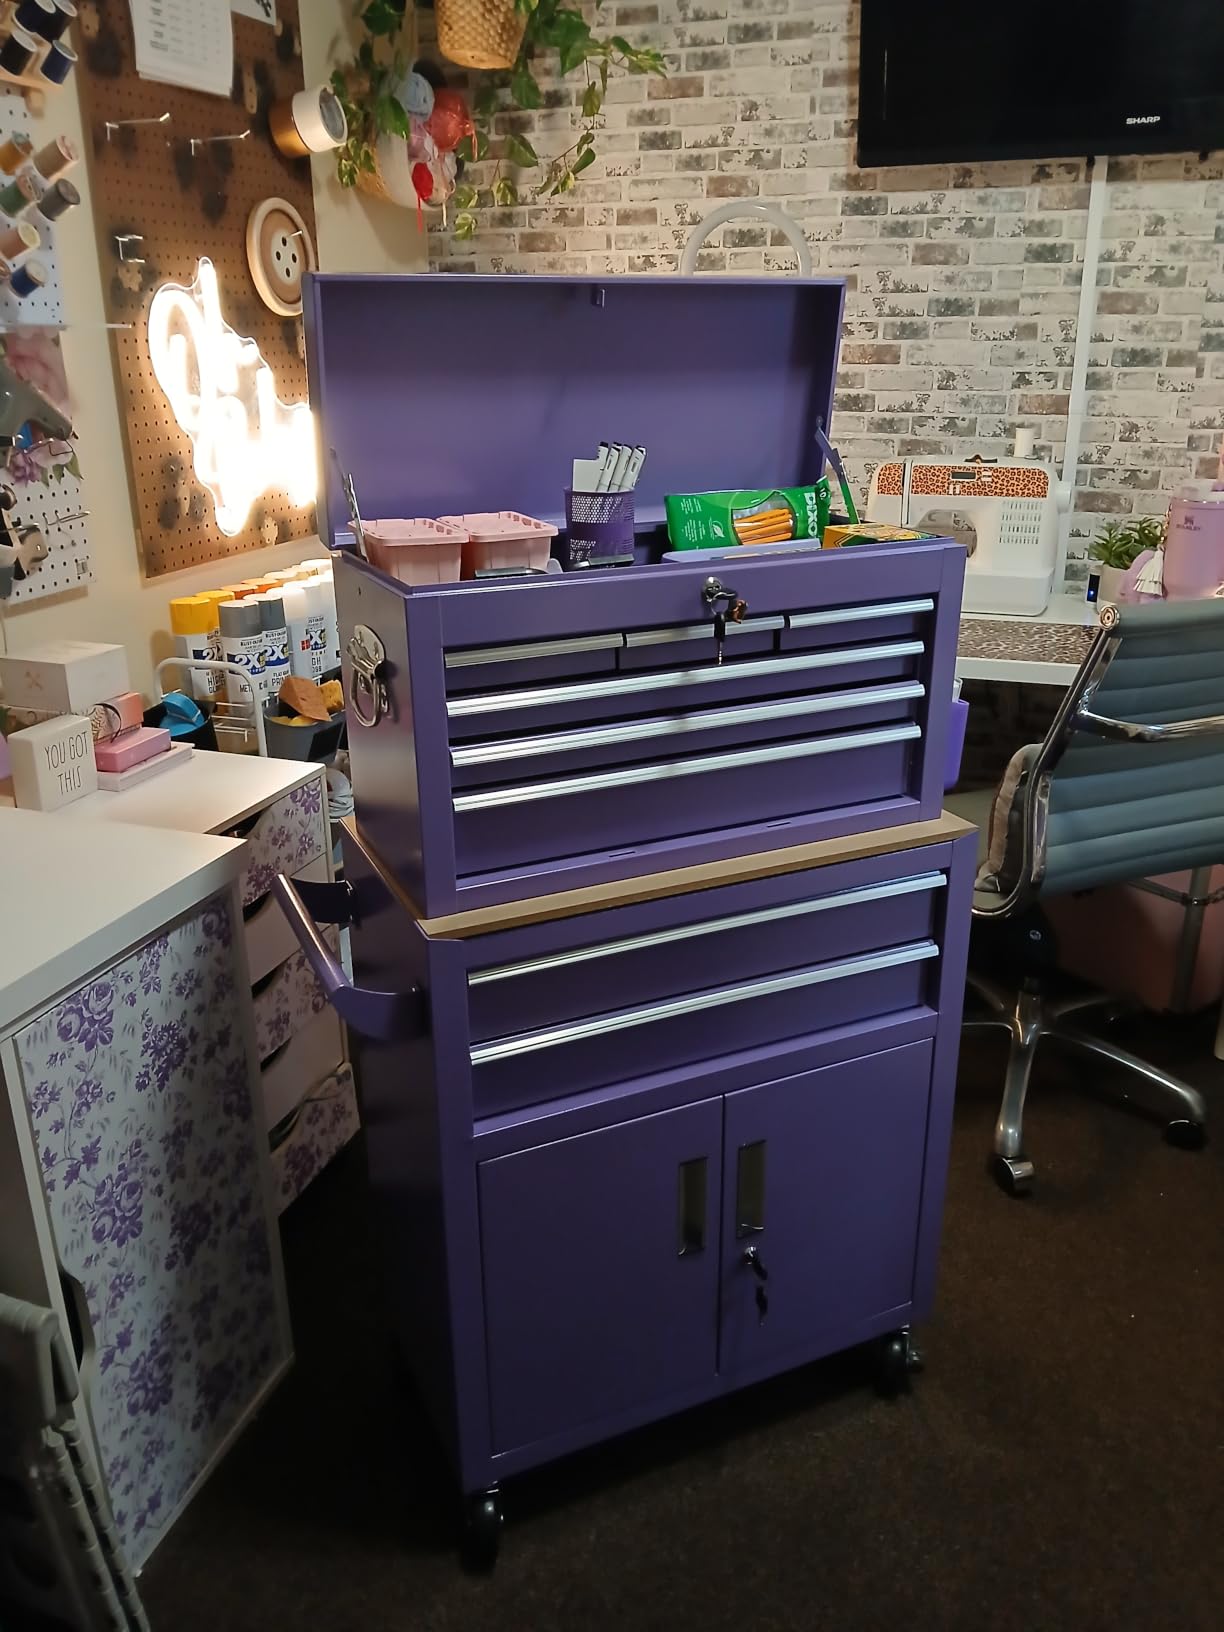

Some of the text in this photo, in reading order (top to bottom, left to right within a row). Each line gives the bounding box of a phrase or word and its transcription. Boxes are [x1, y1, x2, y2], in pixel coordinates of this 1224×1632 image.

[1126, 115, 1161, 125] SHARP
[804, 493, 818, 537] DIXO
[44, 730, 88, 771] YOU GOT
[57, 765, 82, 795] THIS
